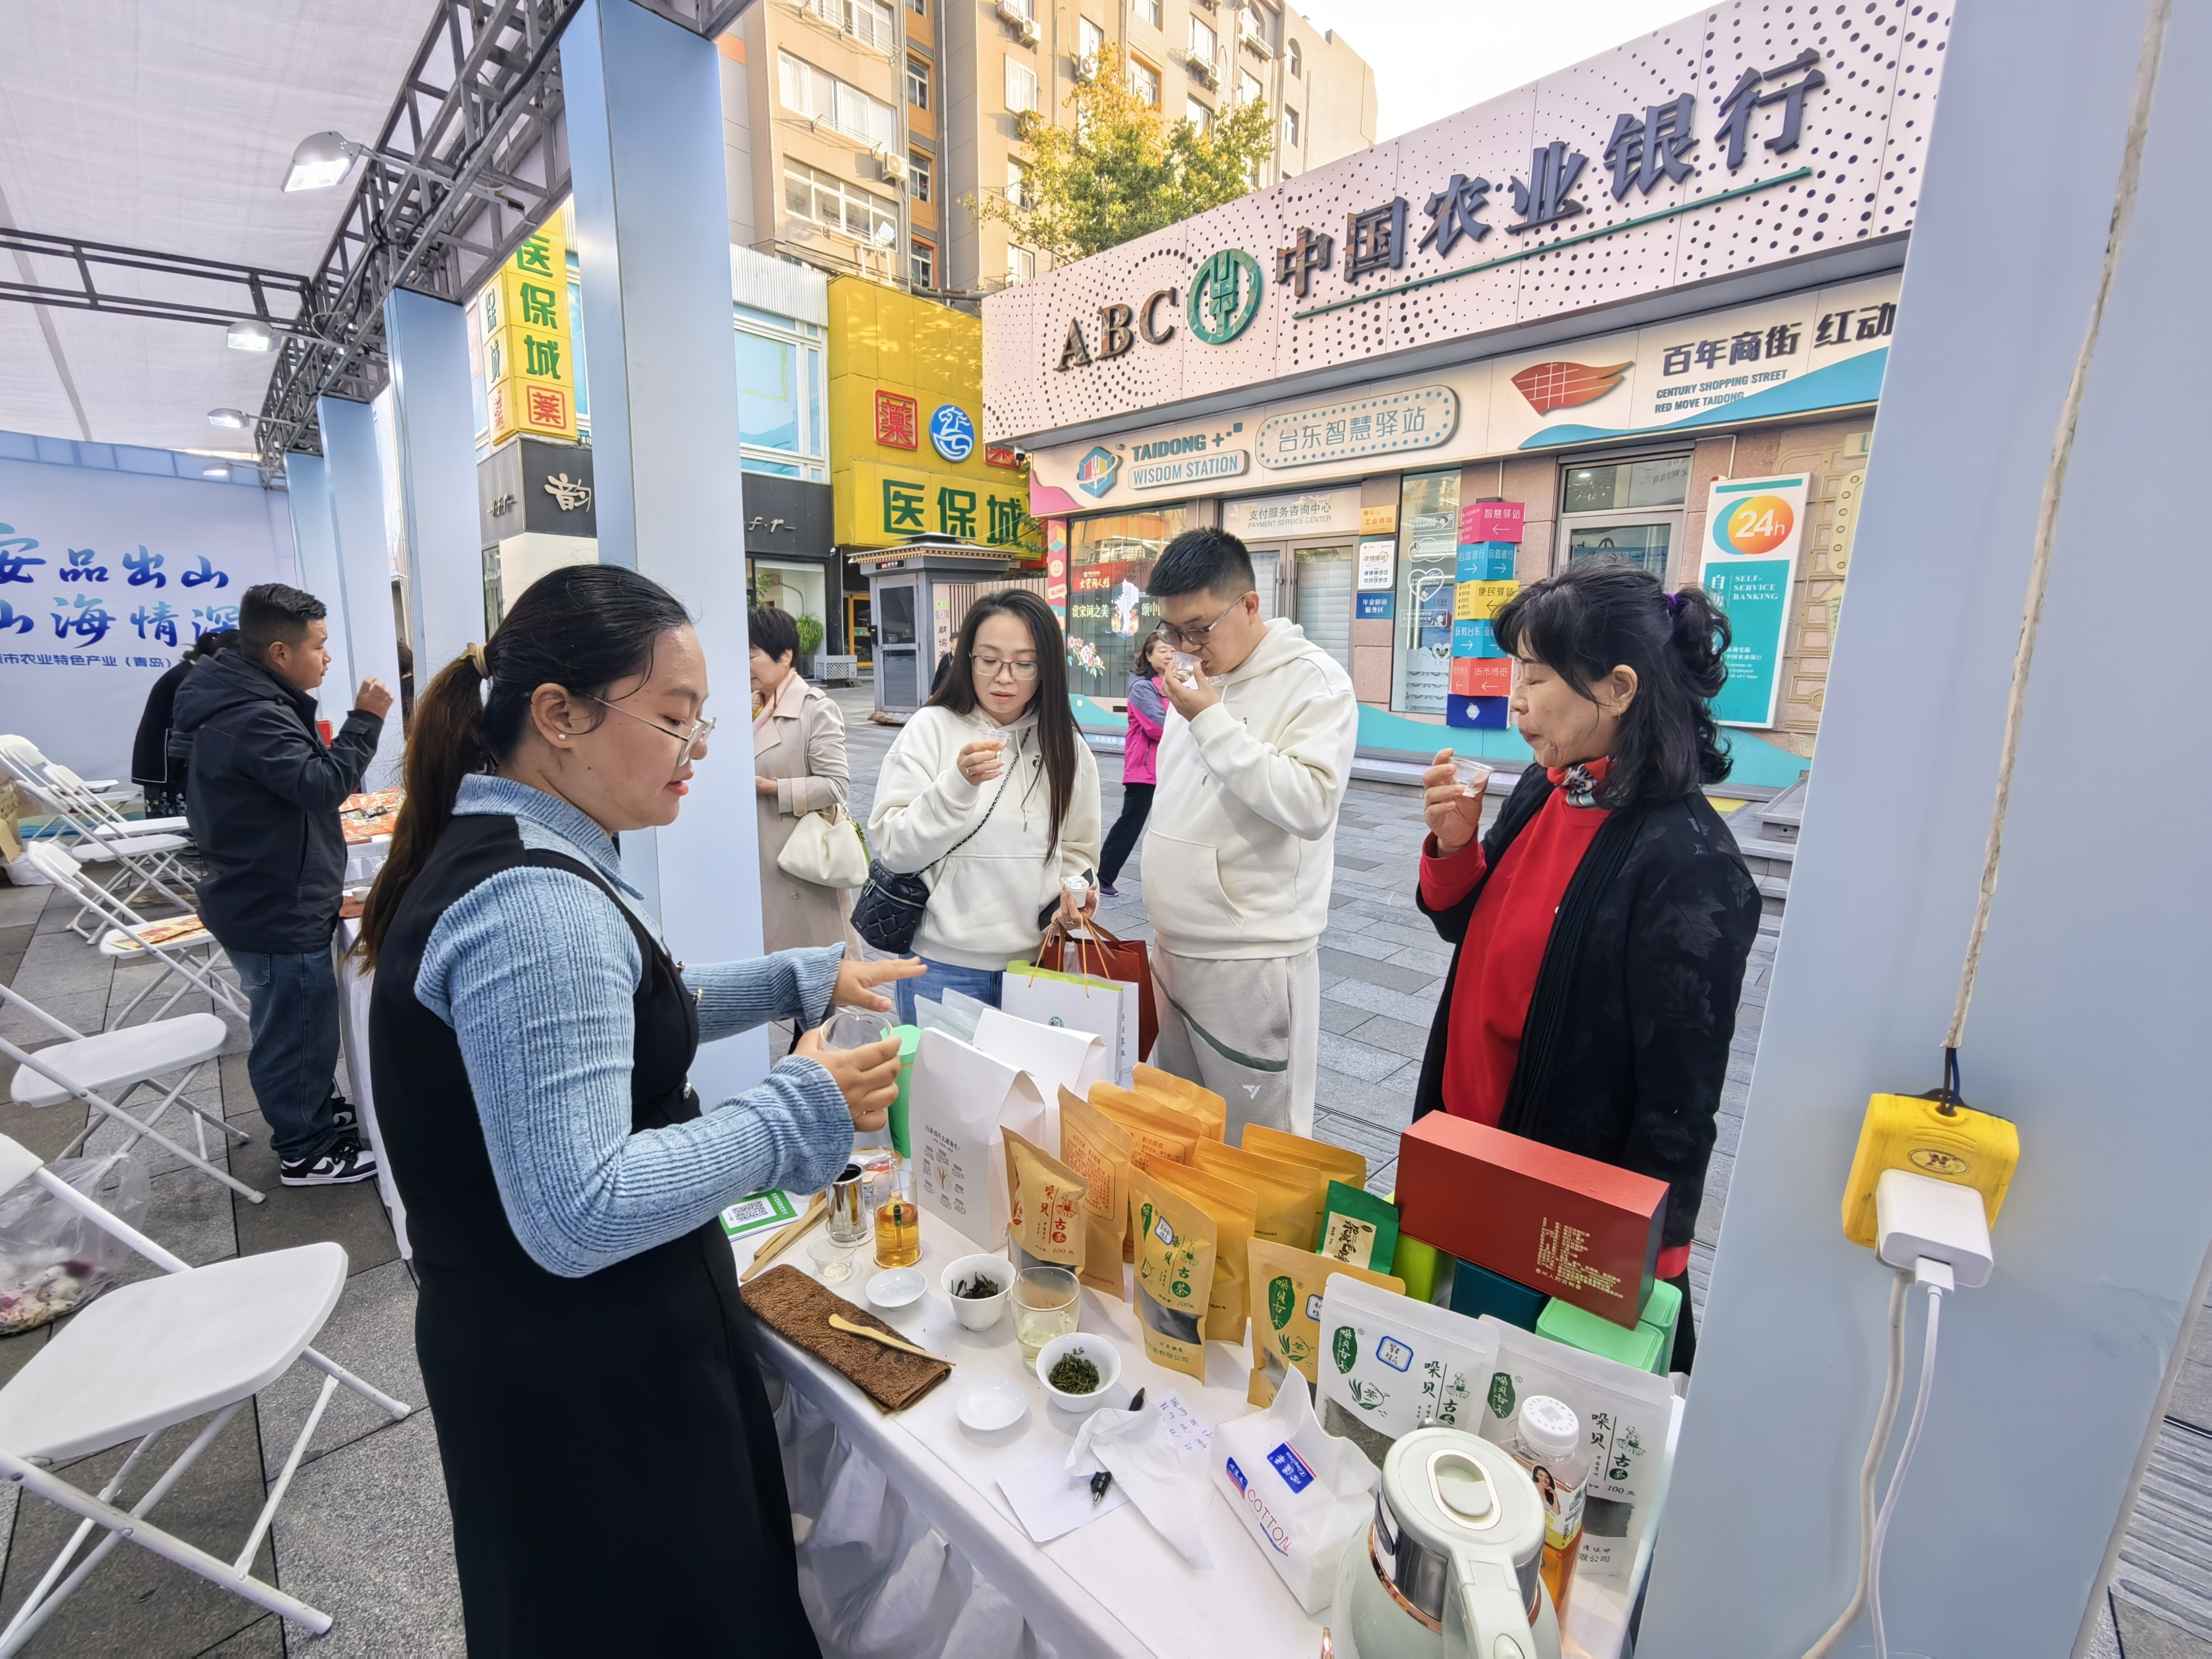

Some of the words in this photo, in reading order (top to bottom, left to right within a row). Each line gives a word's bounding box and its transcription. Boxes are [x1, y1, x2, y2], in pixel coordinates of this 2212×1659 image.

[1276, 48, 1825, 298] 中国农业银行
[516, 234, 561, 380] 医保城
[1054, 287, 1177, 372] ABC
[1663, 322, 1803, 376] 百年商街
[1656, 383, 1697, 399] CENTURY
[1699, 375, 1748, 392] SHOPPING
[1750, 369, 1788, 383] STREET
[1655, 403, 1672, 413] RED
[1675, 398, 1699, 410] MOVE
[1703, 391, 1744, 406] TAIDONG
[1279, 406, 1426, 453] 台东智慧驿站
[1131, 434, 1206, 462] TAIDONG
[1134, 464, 1182, 485] WISDOM
[1186, 455, 1237, 477] STATION
[883, 480, 1022, 541] 医保城
[1249, 502, 1331, 521] 支付服务咨询中心
[1365, 517, 1393, 525] 工会驿站
[1484, 509, 1520, 519] 智慧驿站
[1735, 509, 1786, 538] 24h
[1459, 549, 1485, 562] 自助银行
[1488, 549, 1513, 560] 自助银行
[1050, 586, 1065, 597] BLING
[1479, 586, 1514, 597] 便民驿站
[1072, 604, 1109, 618] 赏宋词之美
[1141, 601, 1161, 617] 颂中
[1455, 626, 1481, 636] 玩转台东
[1474, 667, 1507, 676] 货币博览
[1174, 1266, 1191, 1296] 古茶
[1422, 1361, 1442, 1398] 哚贝
[1590, 1412, 1611, 1450] 哚贝
[1610, 1453, 1631, 1480] 古茶
[1607, 1485, 1624, 1494] 100
[1247, 1489, 1292, 1552] COTTON
